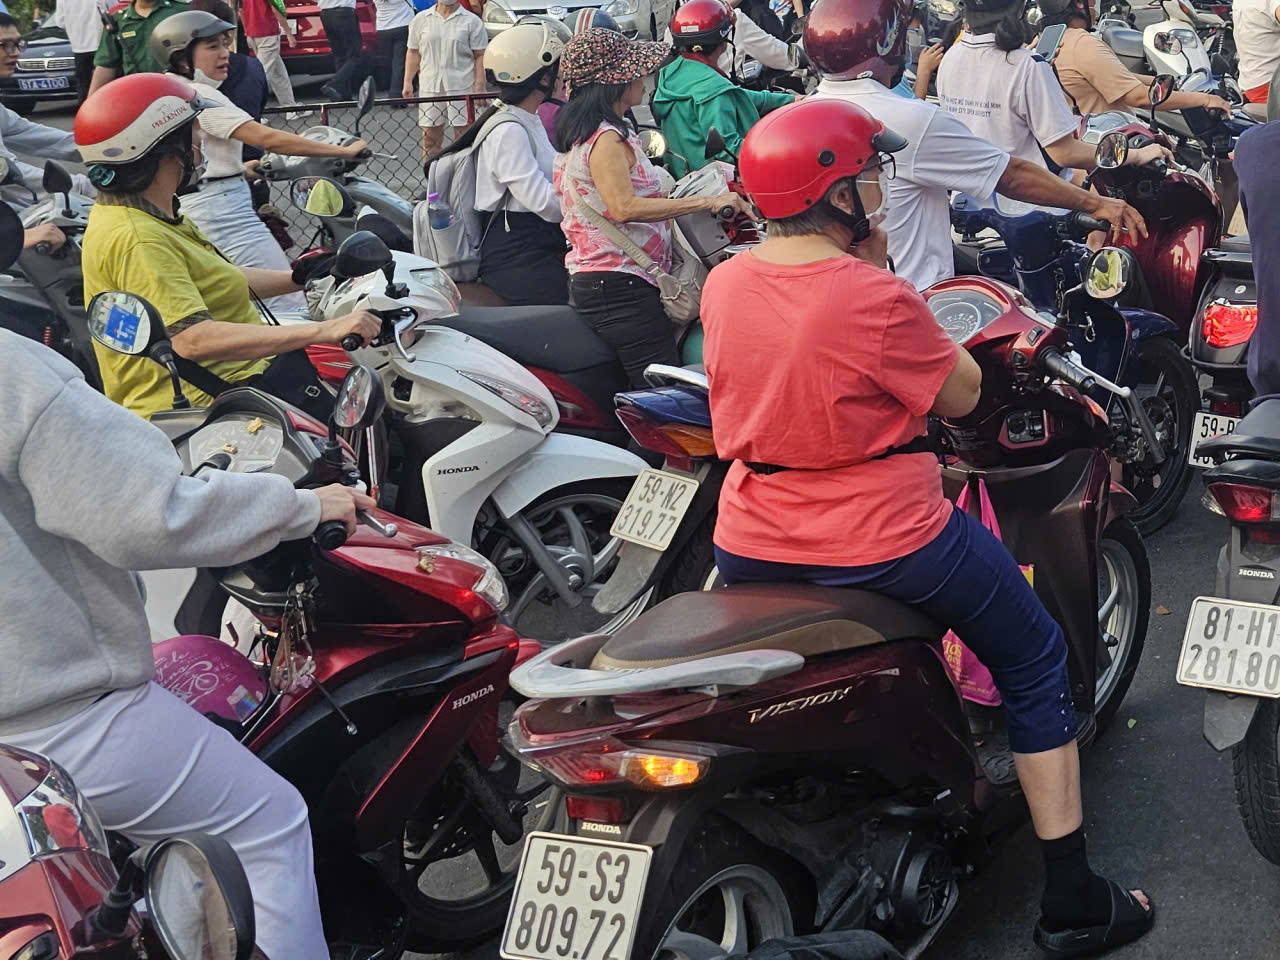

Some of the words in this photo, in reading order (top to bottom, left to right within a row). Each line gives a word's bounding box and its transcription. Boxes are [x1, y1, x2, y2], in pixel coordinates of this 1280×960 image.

[151, 105, 188, 129] PRUDENTIAL
[437, 465, 480, 476] HONDA
[637, 474, 688, 512] 59-N2
[617, 504, 678, 543] 319.77
[1238, 568, 1275, 580] HONDA
[1203, 606, 1279, 648] 81-H1
[452, 683, 495, 710] HONDA
[748, 686, 853, 724] VISION
[581, 821, 622, 835] HONDA
[536, 844, 631, 904] 59-S3
[514, 900, 626, 960] 809.72
